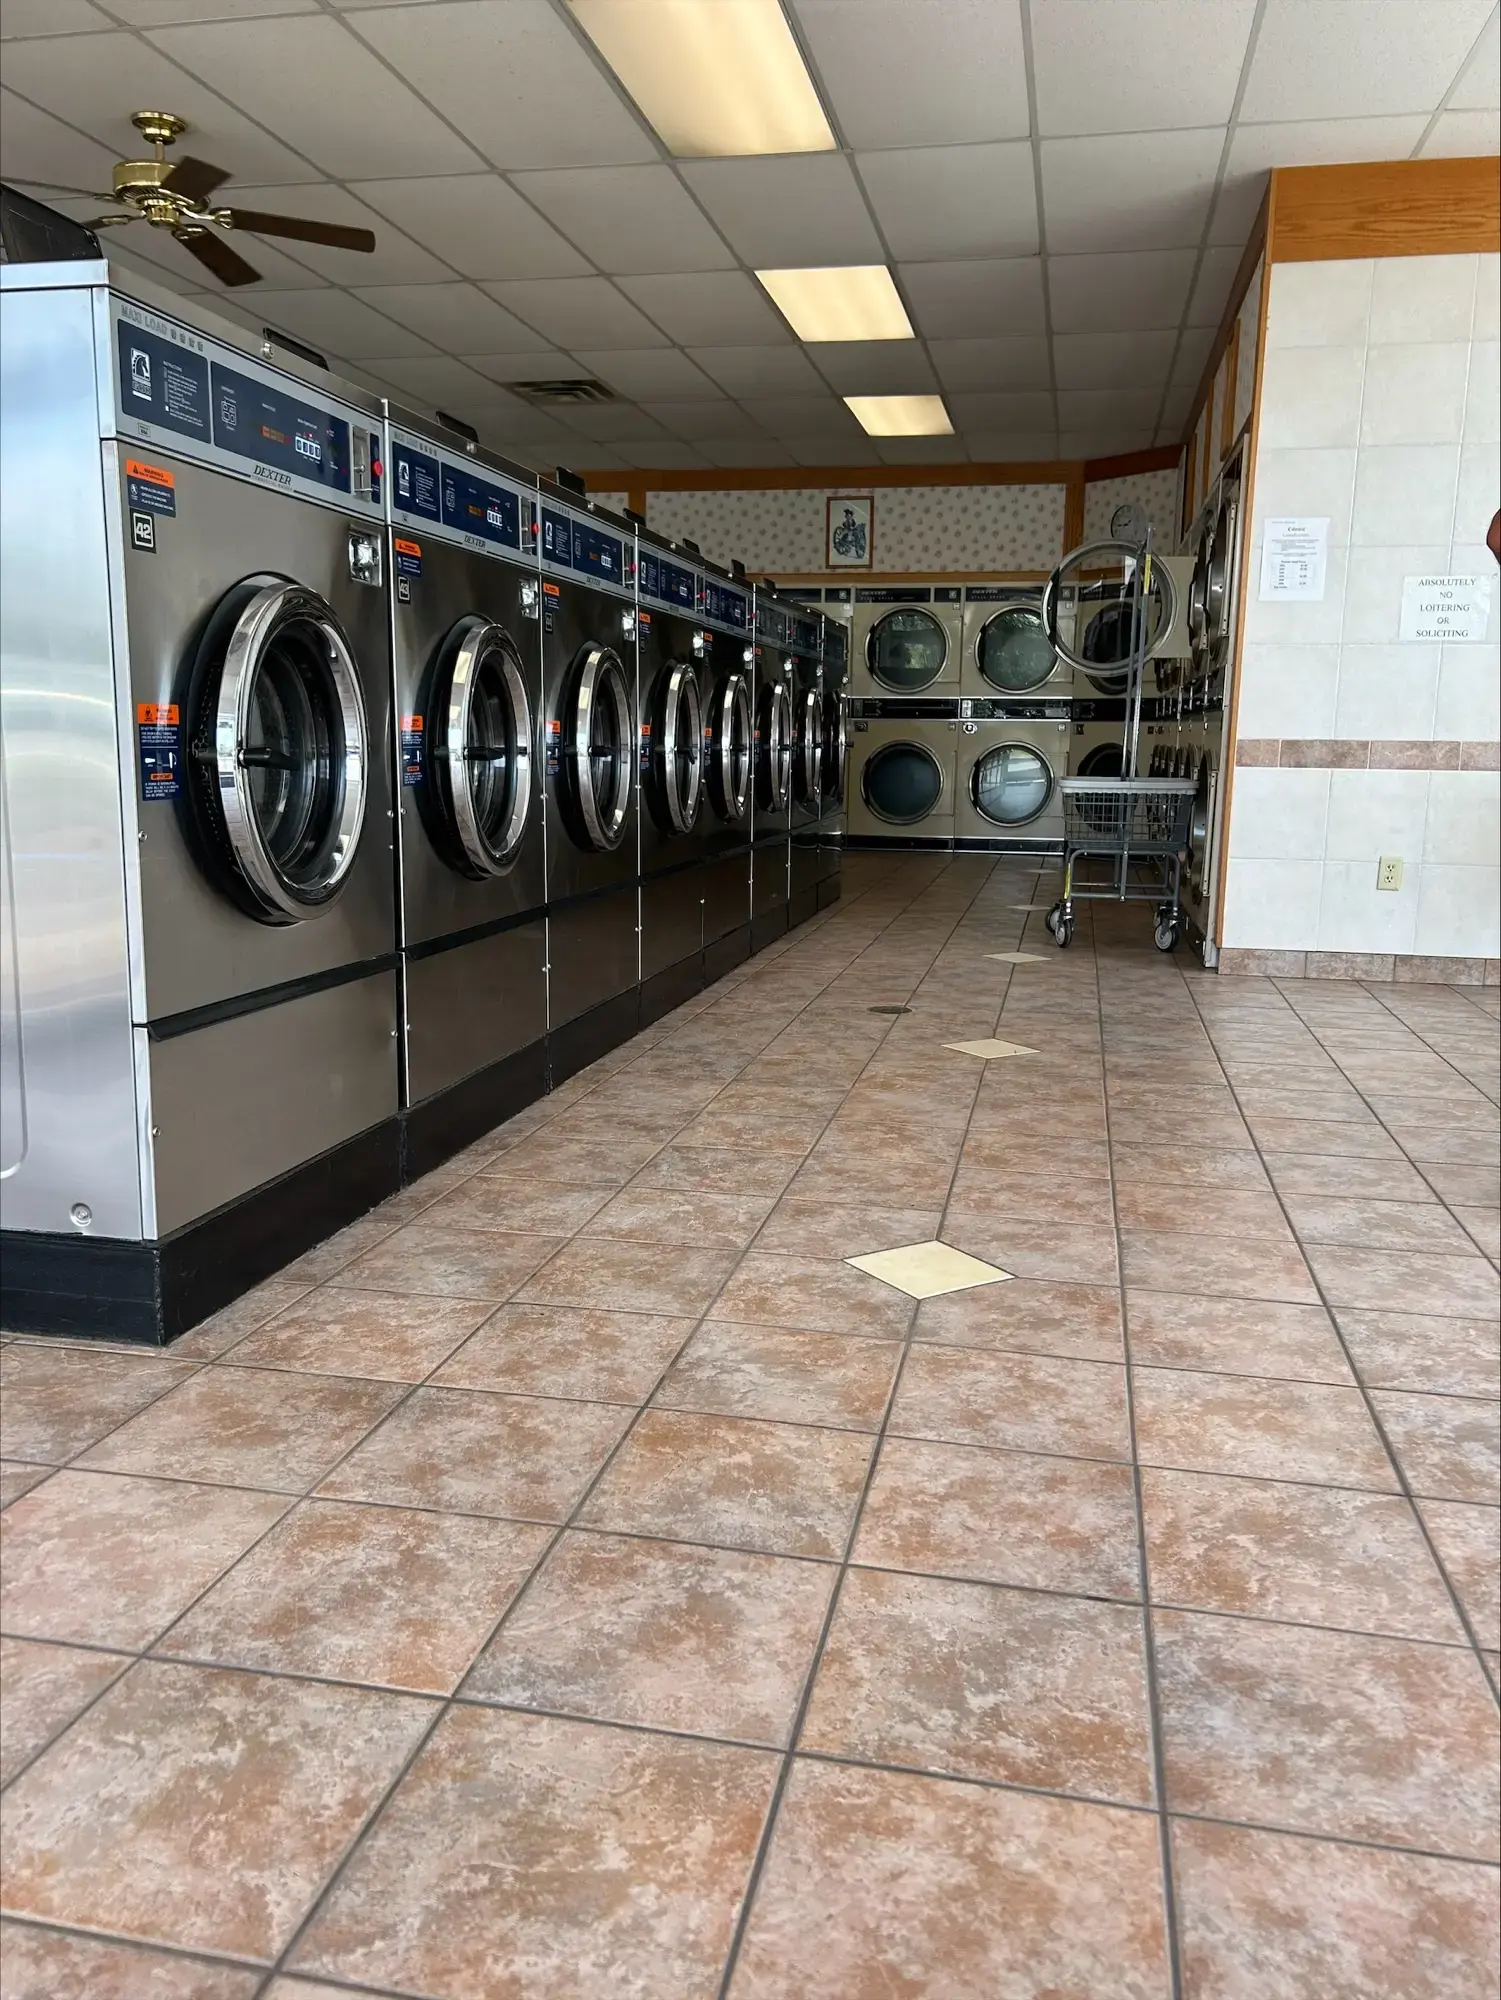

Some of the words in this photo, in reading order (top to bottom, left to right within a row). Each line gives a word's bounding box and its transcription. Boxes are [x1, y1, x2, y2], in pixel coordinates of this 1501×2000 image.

[121, 304, 142, 325] MAXI
[145, 315, 168, 336] LOAD
[253, 465, 292, 486] DEXTER
[136, 522, 152, 540] 42
[464, 535, 486, 549] DEXTER
[1419, 578, 1476, 587] ABSOLUTELY
[1440, 591, 1453, 600] NO
[1420, 604, 1470, 613] LOITERING
[1437, 617, 1451, 626] OR
[1416, 629, 1469, 638] SOLICITING
